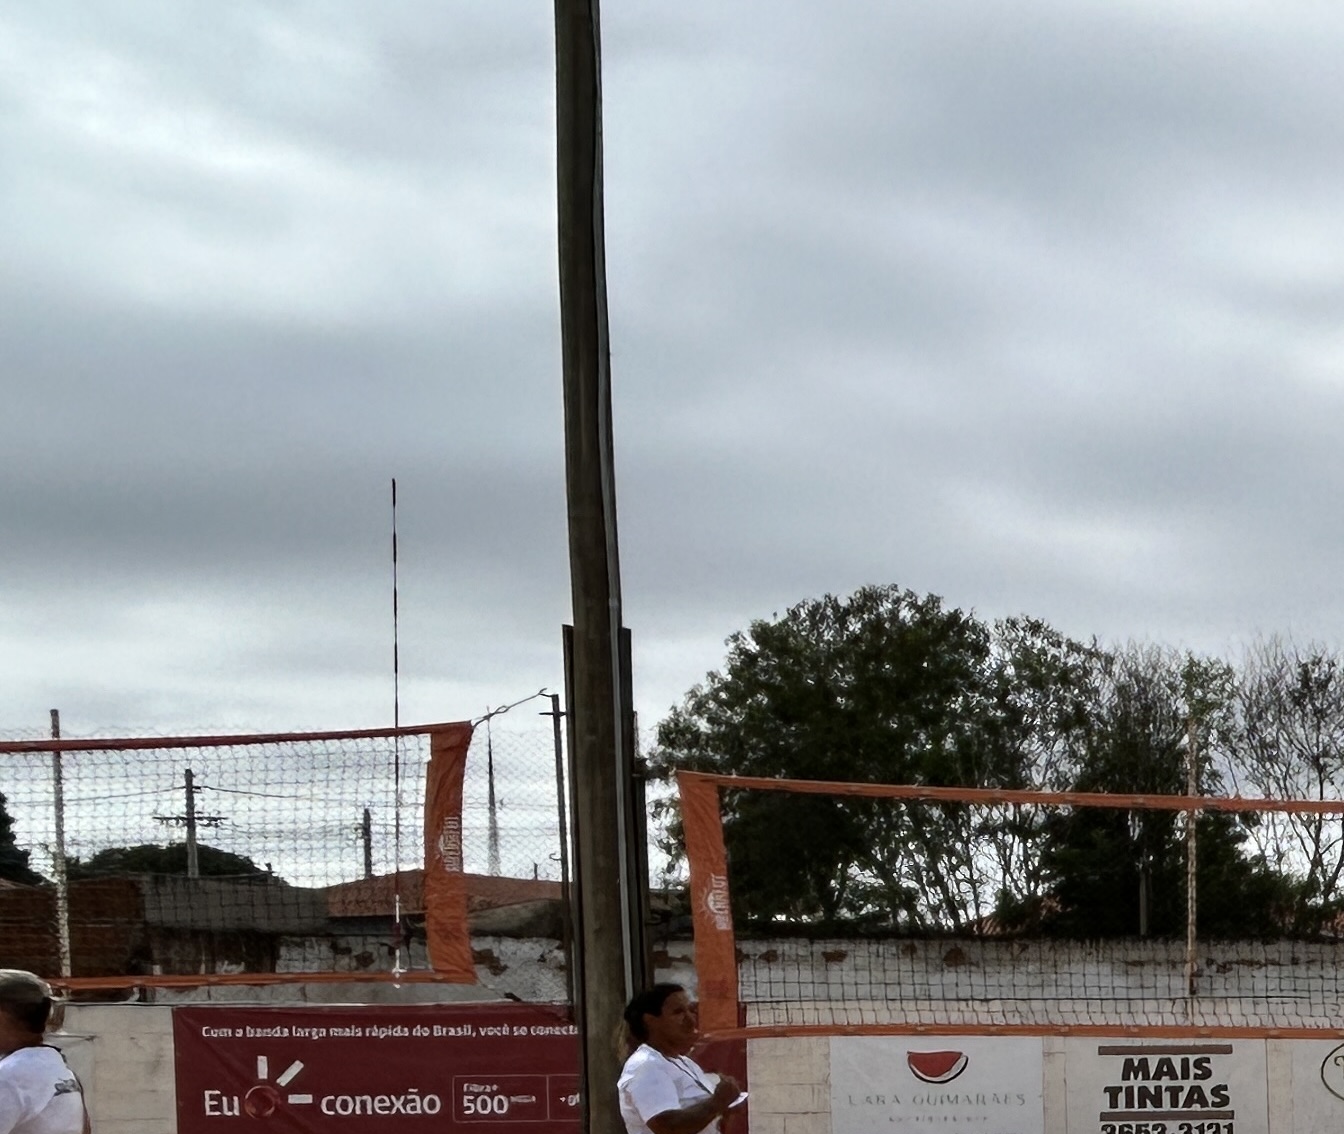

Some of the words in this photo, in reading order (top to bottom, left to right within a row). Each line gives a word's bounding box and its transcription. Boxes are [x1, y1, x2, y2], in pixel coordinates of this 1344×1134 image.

[1122, 1057, 1213, 1081] MAIS
[204, 1090, 240, 1117] Eu
[320, 1088, 441, 1116] conexão
[463, 1094, 509, 1115] 500
[1103, 1084, 1231, 1109] TINTAS
